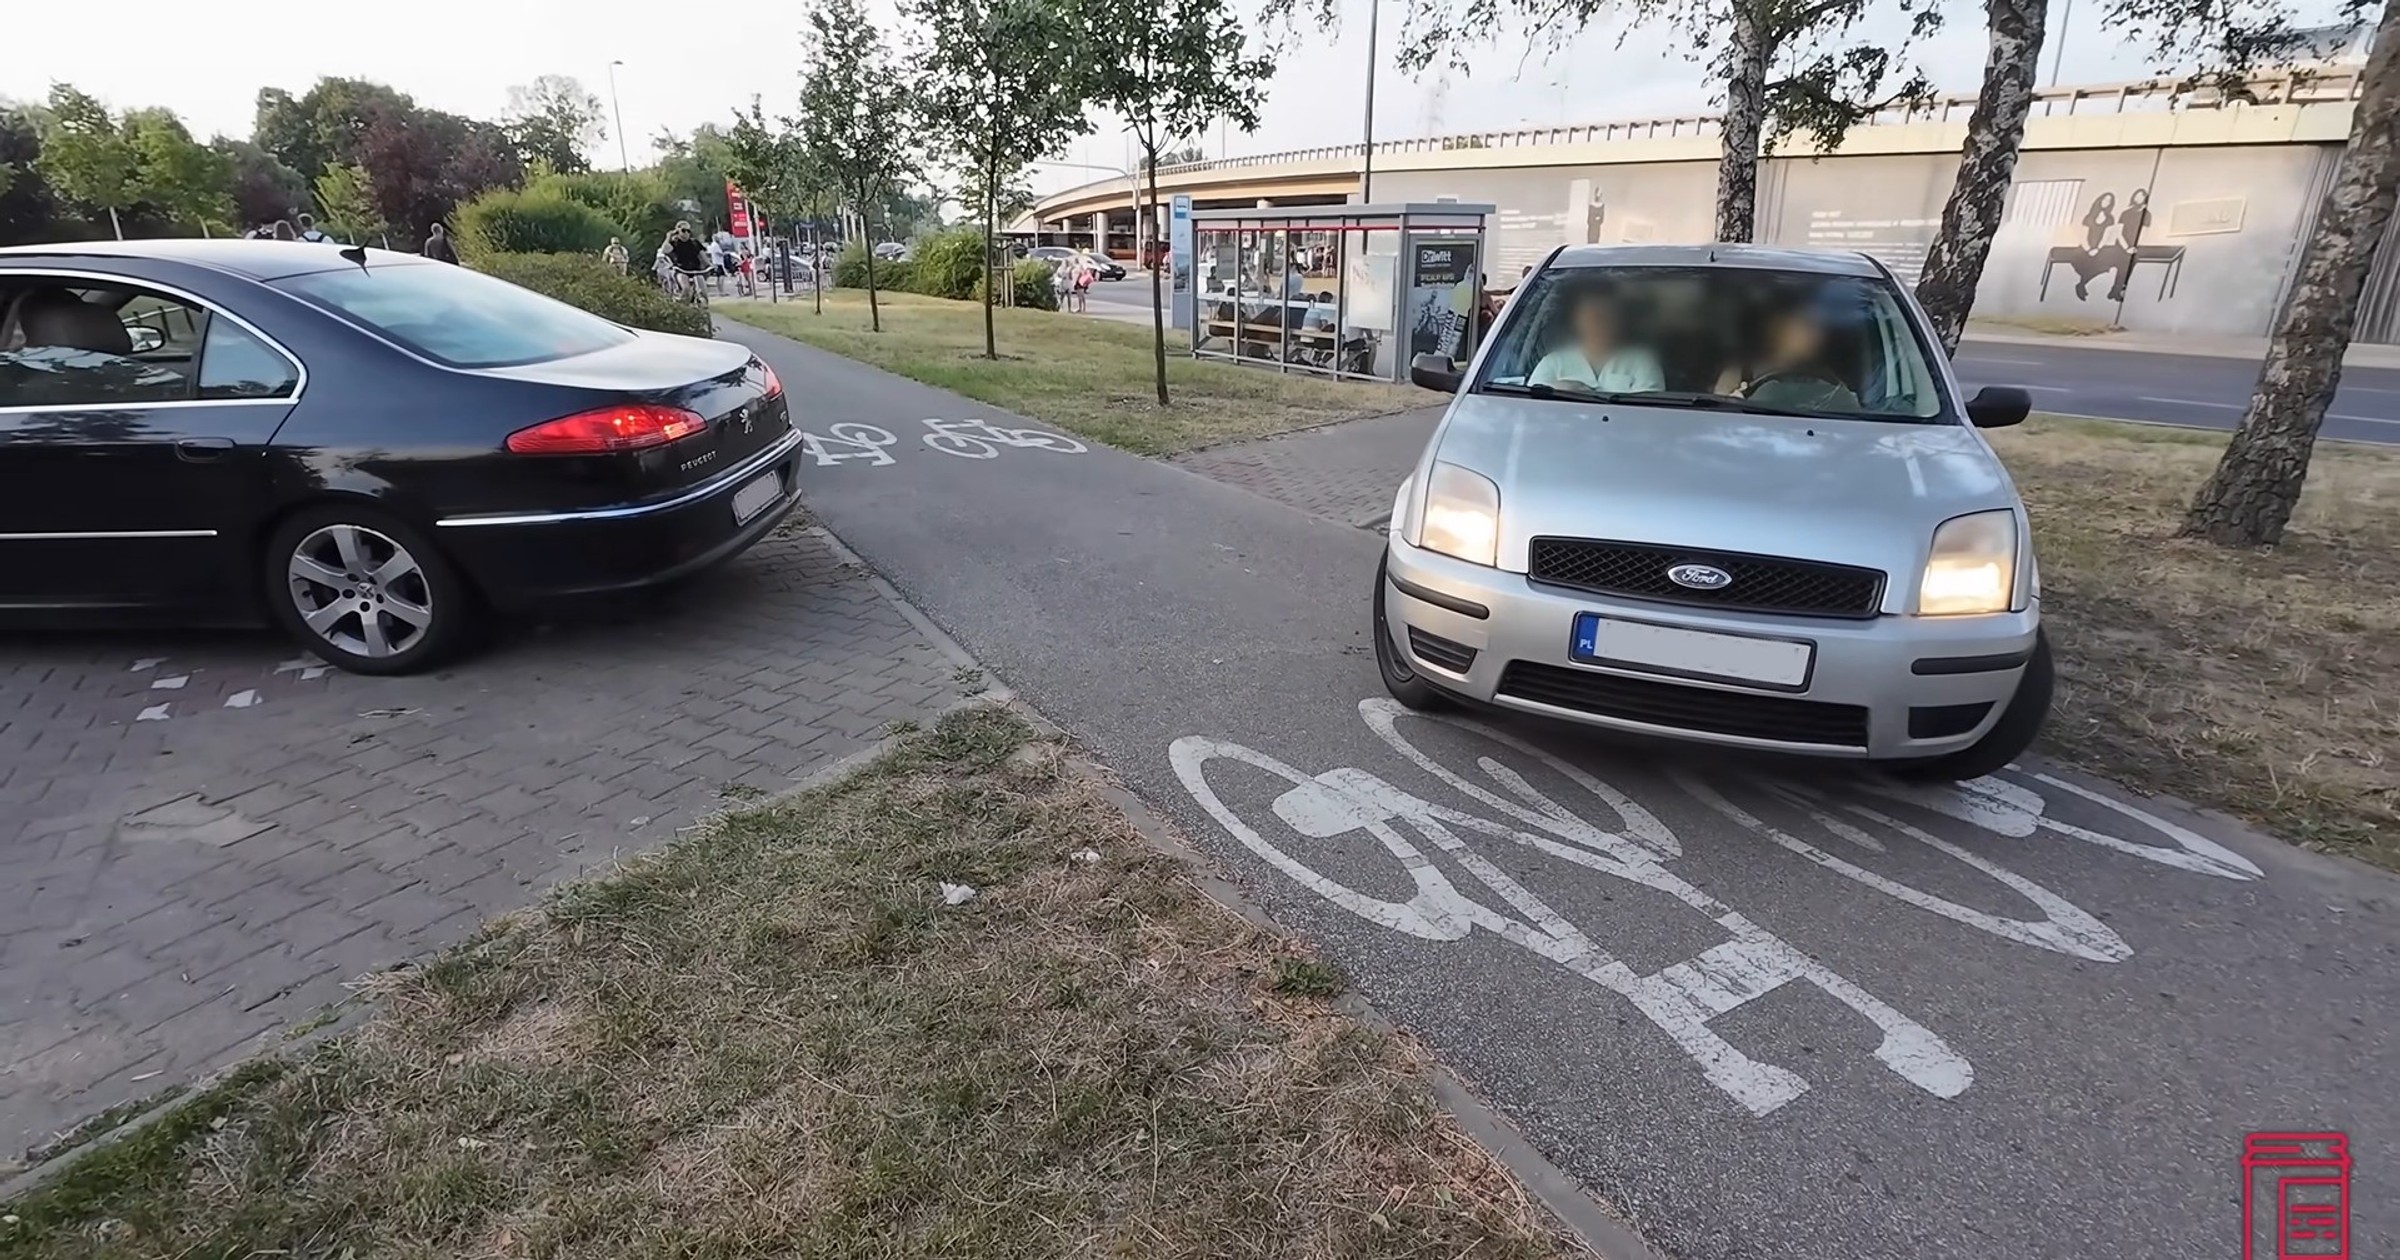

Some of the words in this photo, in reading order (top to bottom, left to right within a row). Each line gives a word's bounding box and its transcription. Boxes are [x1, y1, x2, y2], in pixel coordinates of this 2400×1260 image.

[680, 450, 717, 471] PEUGEOT
[1681, 567, 1719, 584] Ford
[1580, 638, 1593, 649] PL
